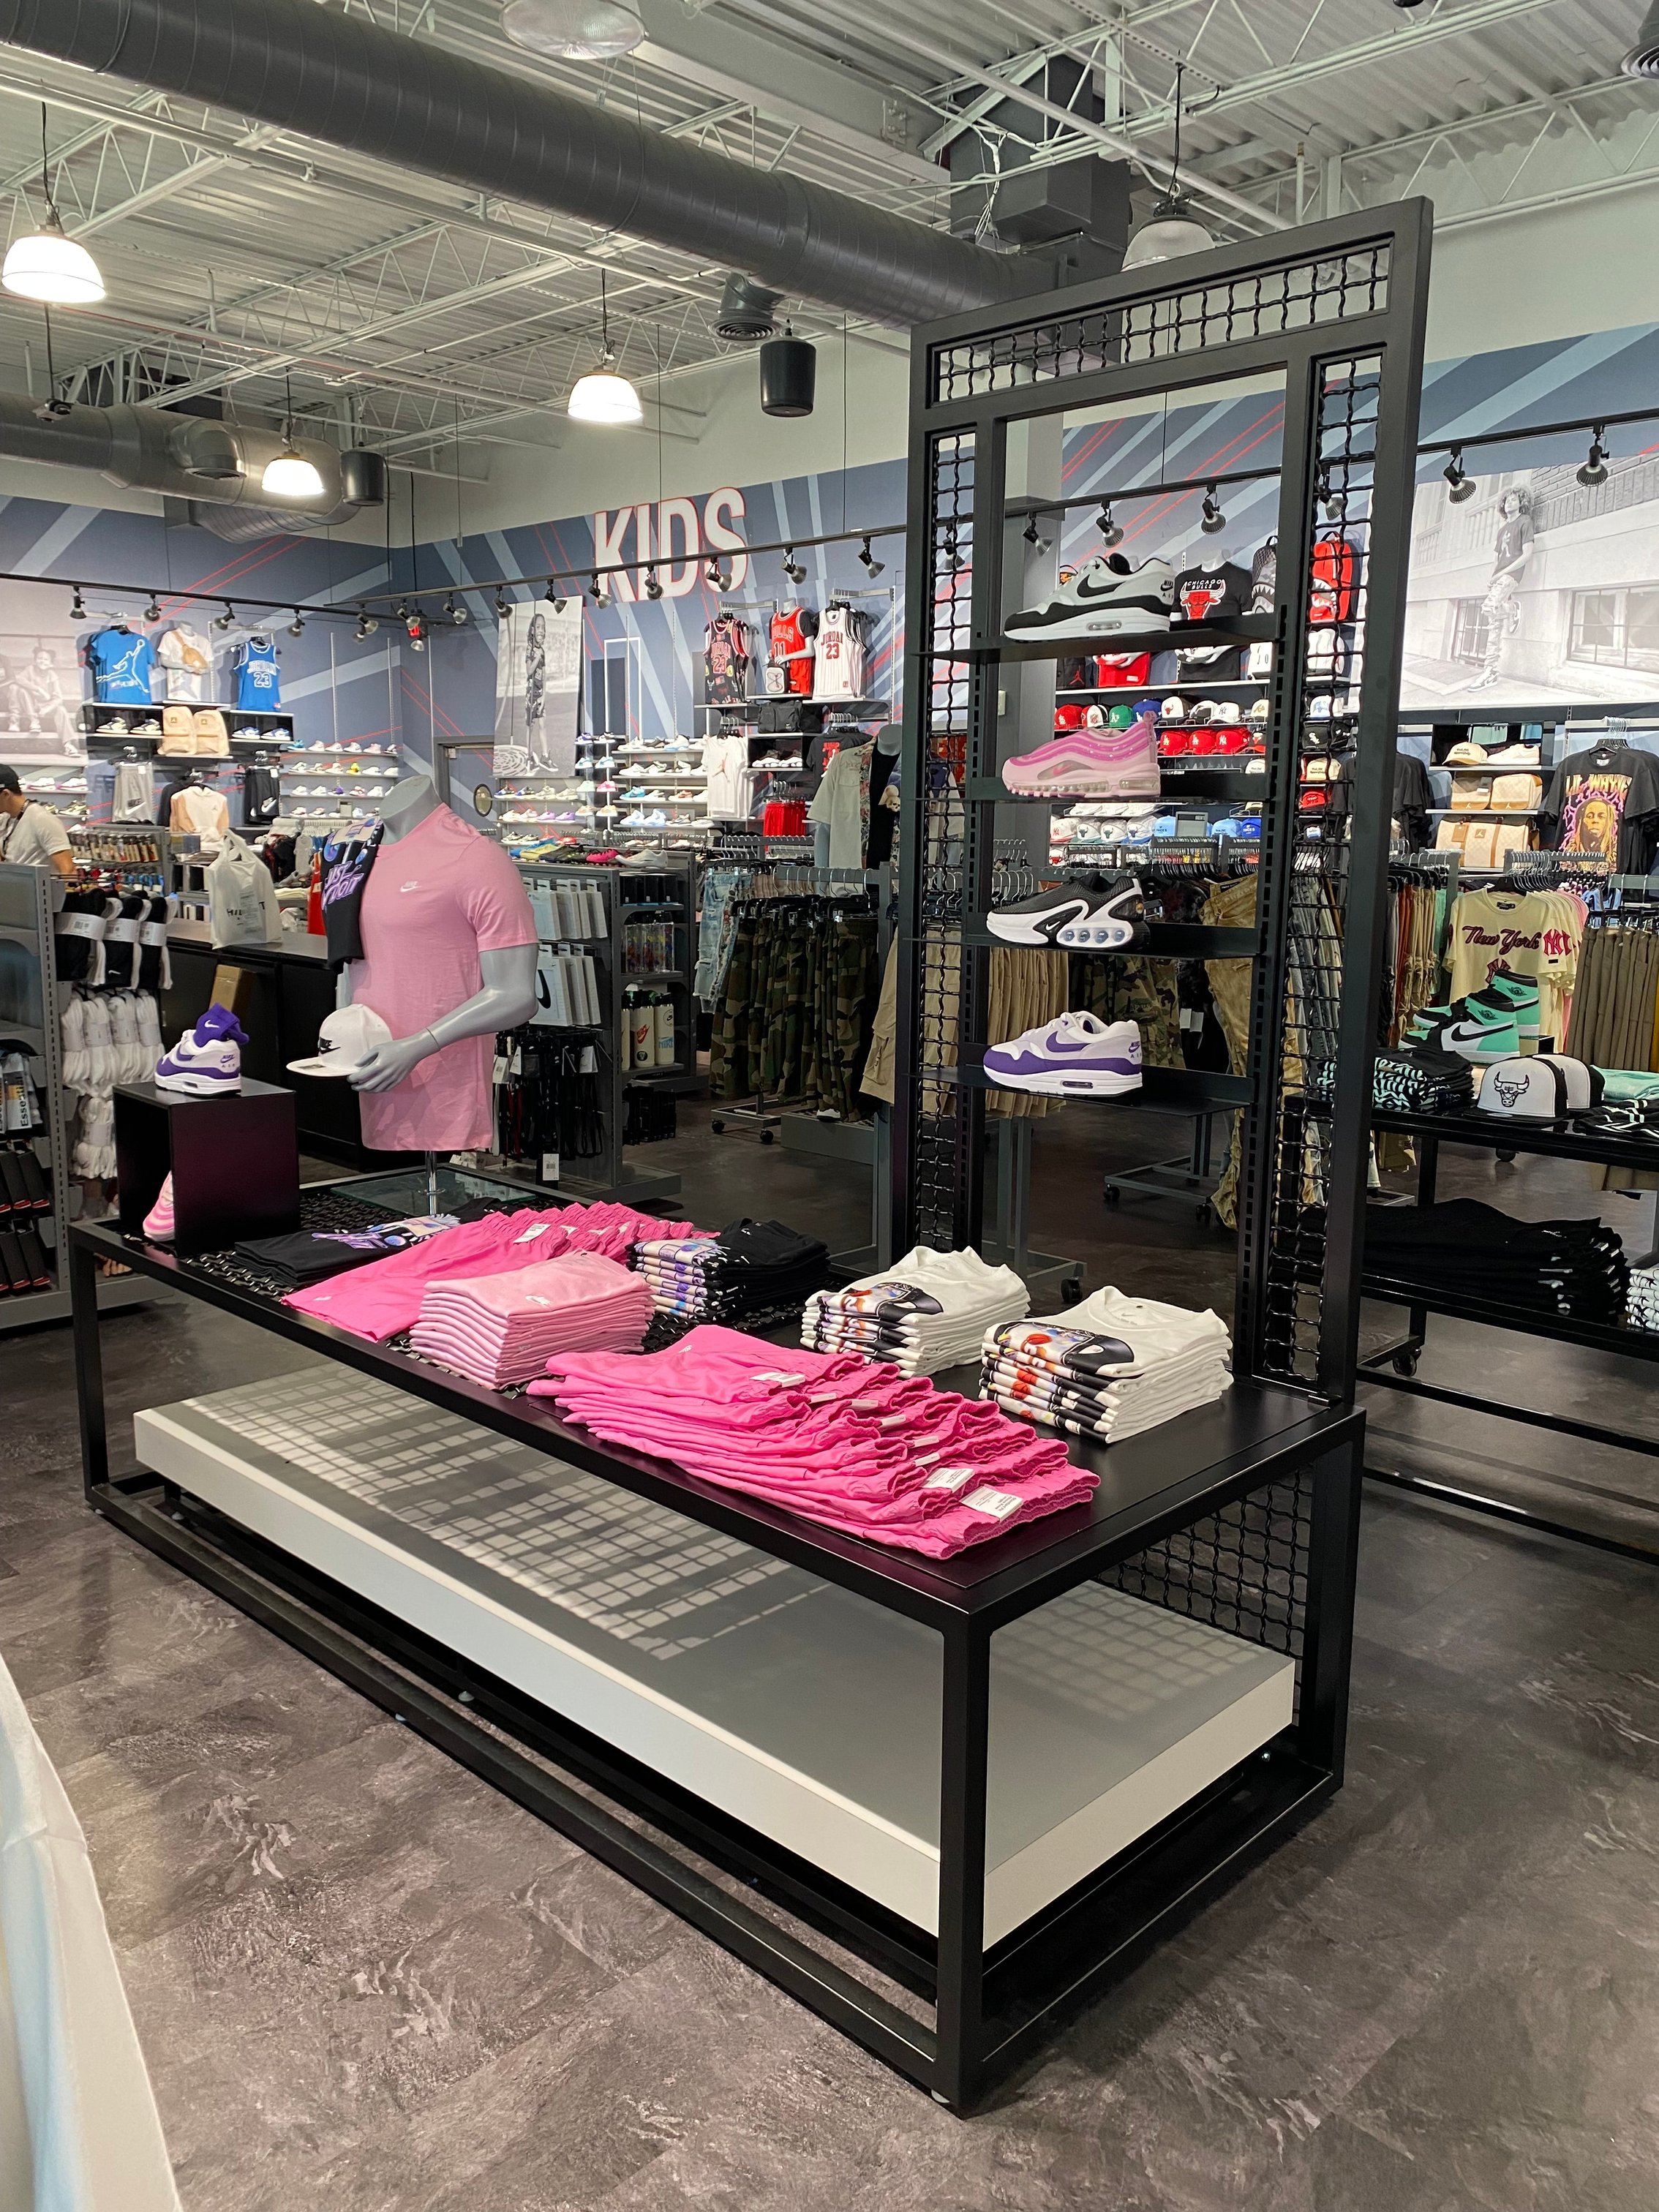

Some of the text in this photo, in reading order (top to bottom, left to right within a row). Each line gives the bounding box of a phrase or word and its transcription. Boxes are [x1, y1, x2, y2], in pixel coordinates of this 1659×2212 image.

[594, 486, 749, 604] KIDS
[1186, 579, 1222, 587] CHICAGO
[826, 643, 840, 660] 23
[713, 655, 726, 674] 23
[253, 672, 271, 688] 23
[1565, 774, 1583, 797] LIL
[1589, 773, 1633, 801] WAYNE
[1462, 925, 1543, 955] New York
